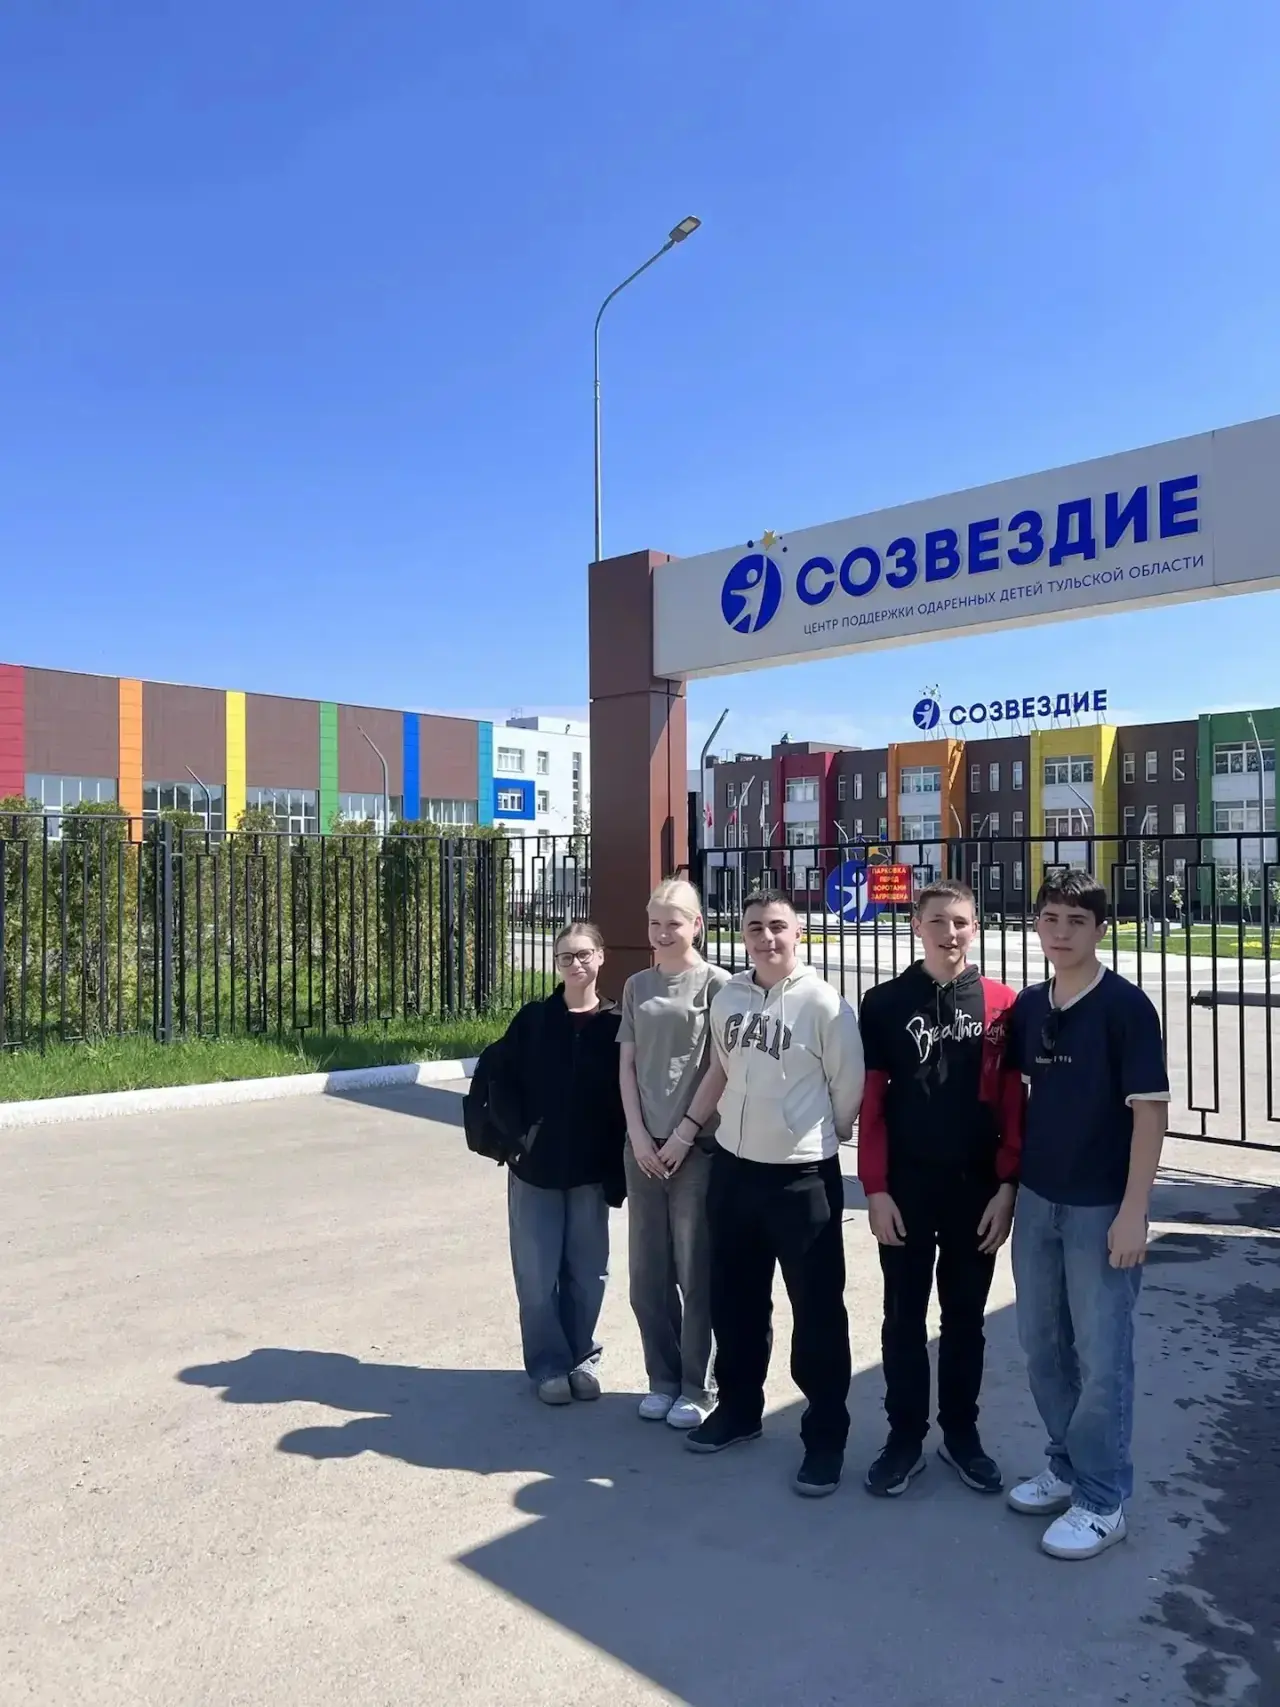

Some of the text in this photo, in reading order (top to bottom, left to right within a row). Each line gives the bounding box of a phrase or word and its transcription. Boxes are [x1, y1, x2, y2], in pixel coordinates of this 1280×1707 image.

[795, 474, 1199, 606] СОЗВЕЗДИЕ
[803, 554, 1205, 635] ЦЕНТР ПОДДЕРЖКИ ОДАРЕННЫХ ДЕТЕЙ ТУЛЬСКОЙ ОБЛАСТИ
[949, 689, 1107, 726] СОЗВЕЗДИЕ
[871, 867, 907, 875] ПАРКОВКА
[879, 875, 900, 883] ПЕРЕД
[871, 892, 909, 901] ЗАПРЕЩЕНА
[723, 1012, 792, 1061] GAP
